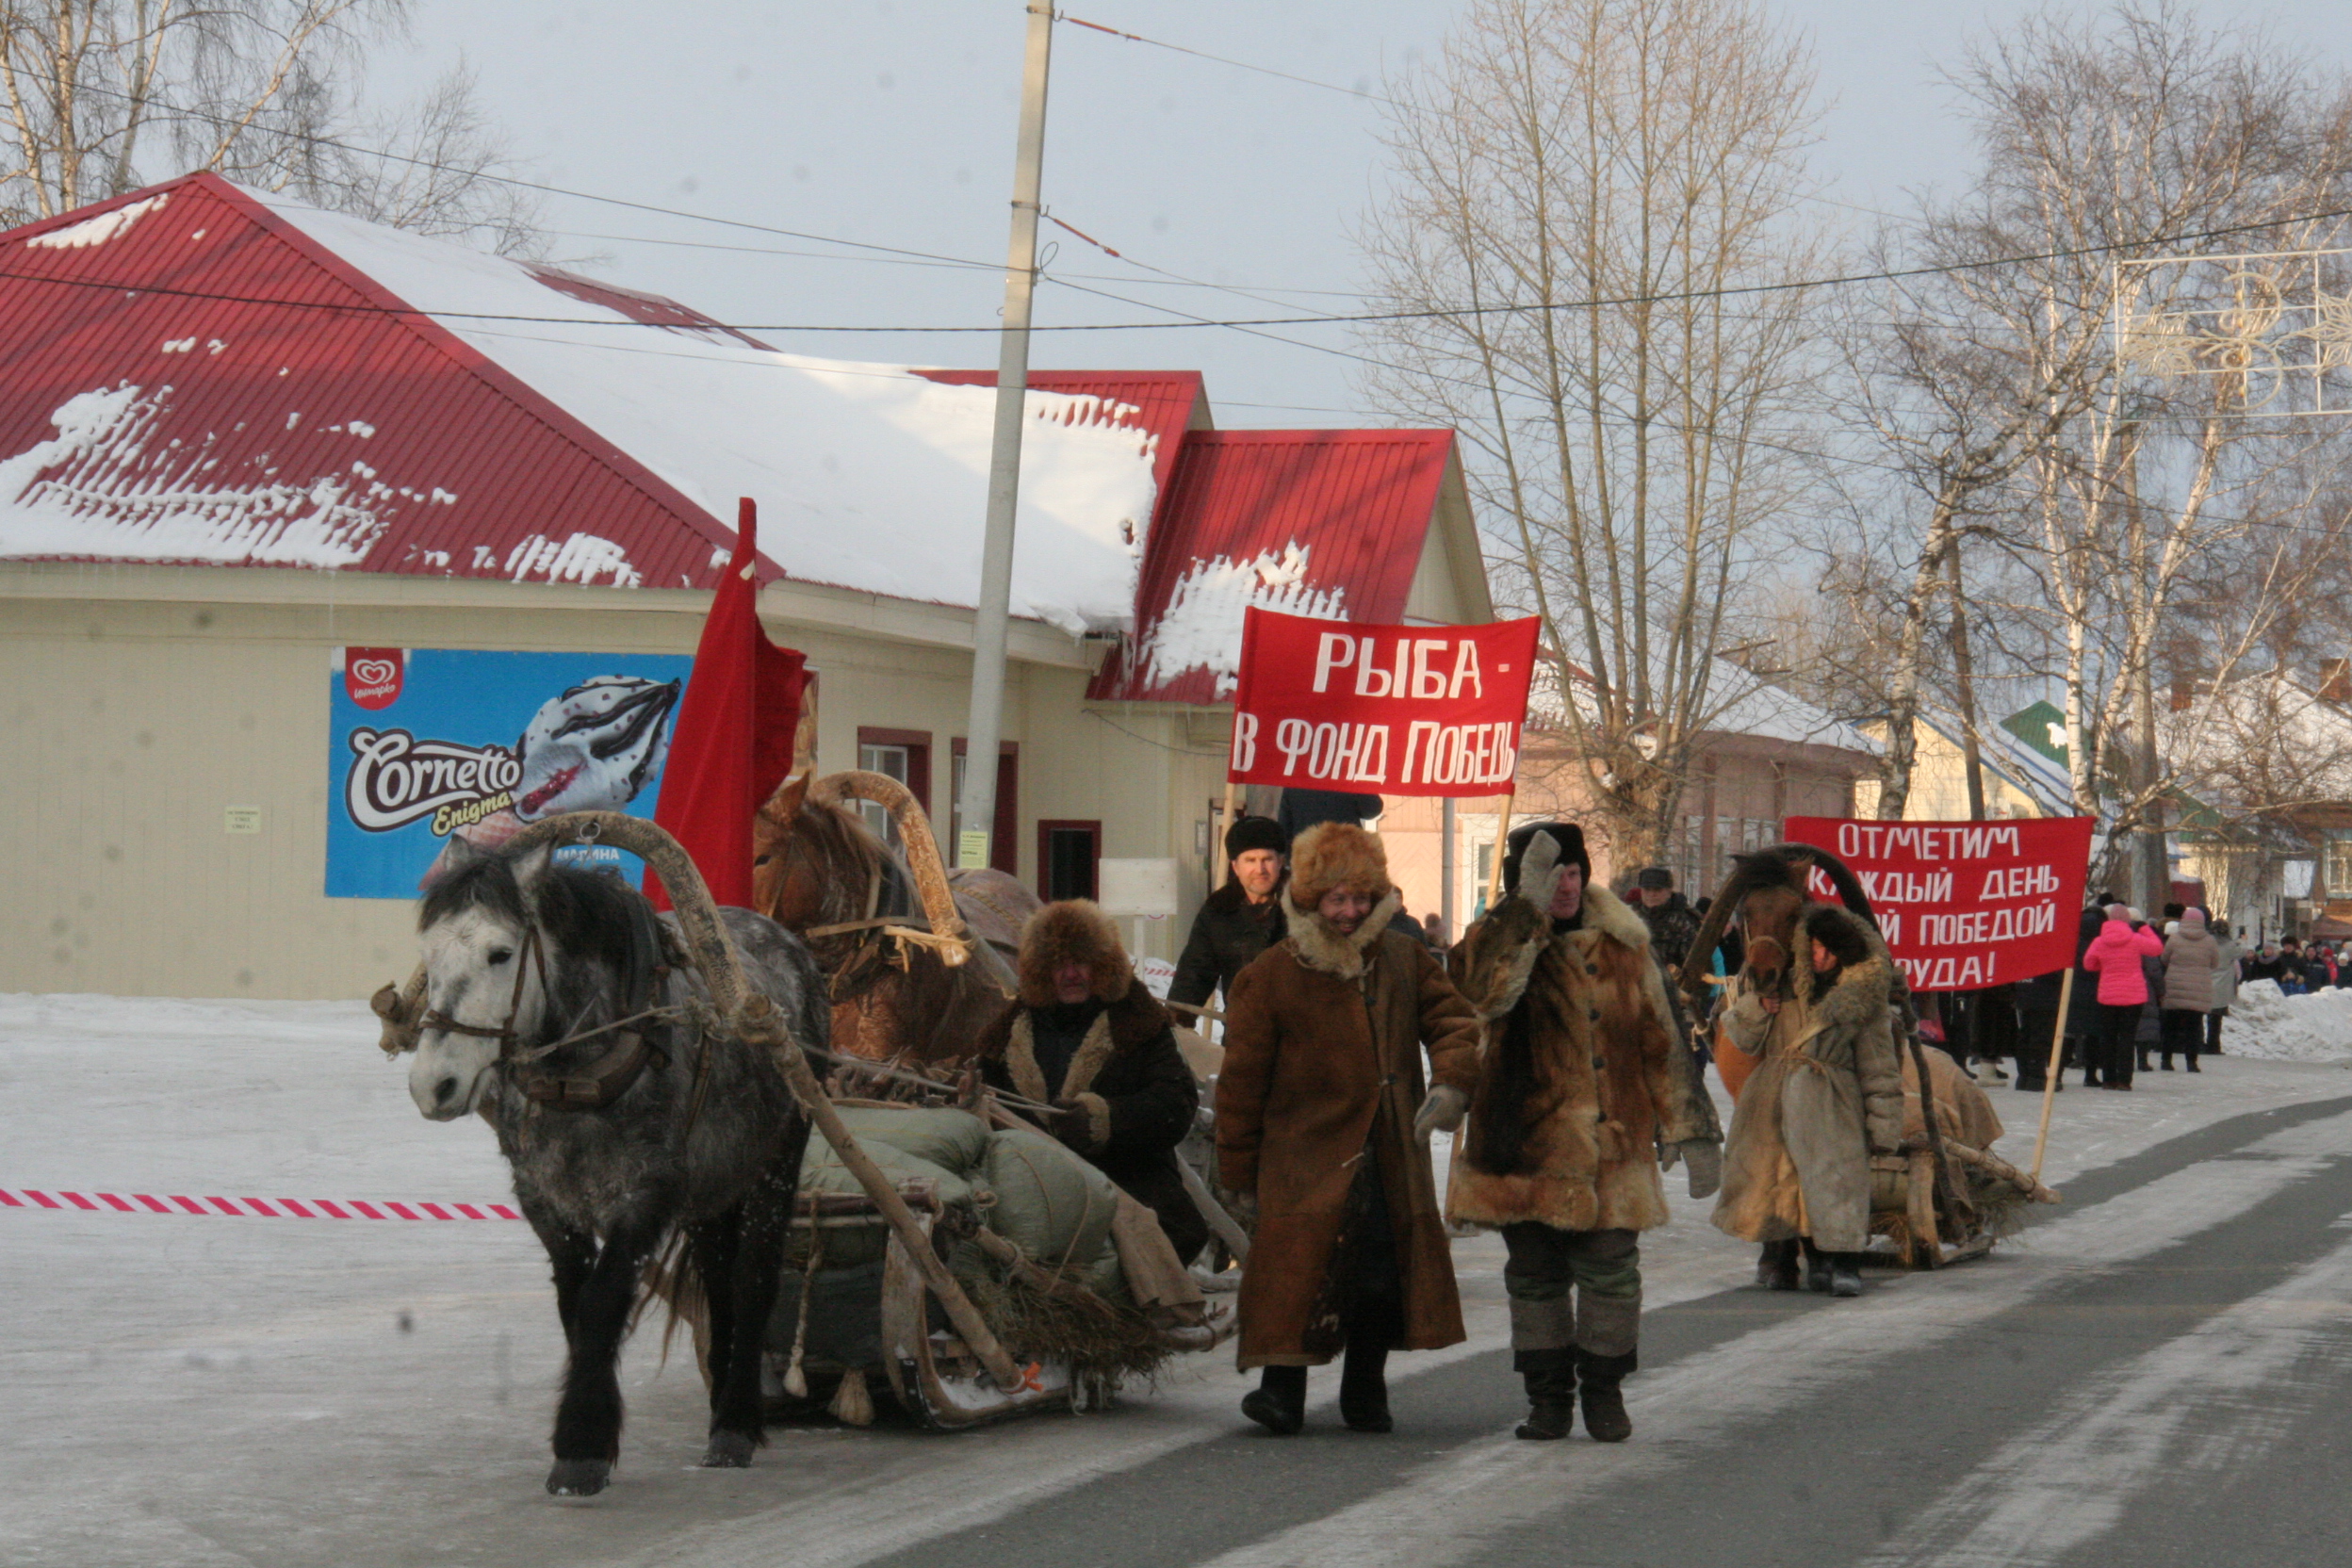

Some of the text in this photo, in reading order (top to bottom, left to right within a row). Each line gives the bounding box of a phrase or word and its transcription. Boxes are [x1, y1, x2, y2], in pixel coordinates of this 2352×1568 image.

[1312, 631, 1482, 699] РЫБА
[1232, 711, 1259, 773] В
[1275, 718, 1390, 786] ФОНД
[349, 728, 522, 830] Cornetto
[432, 790, 512, 836] Enigma
[1838, 823, 2020, 860] ОТМЕТИМ
[1978, 864, 2061, 904] ДЕНЬ
[1919, 898, 2056, 946] ПОБЕДОЙ
